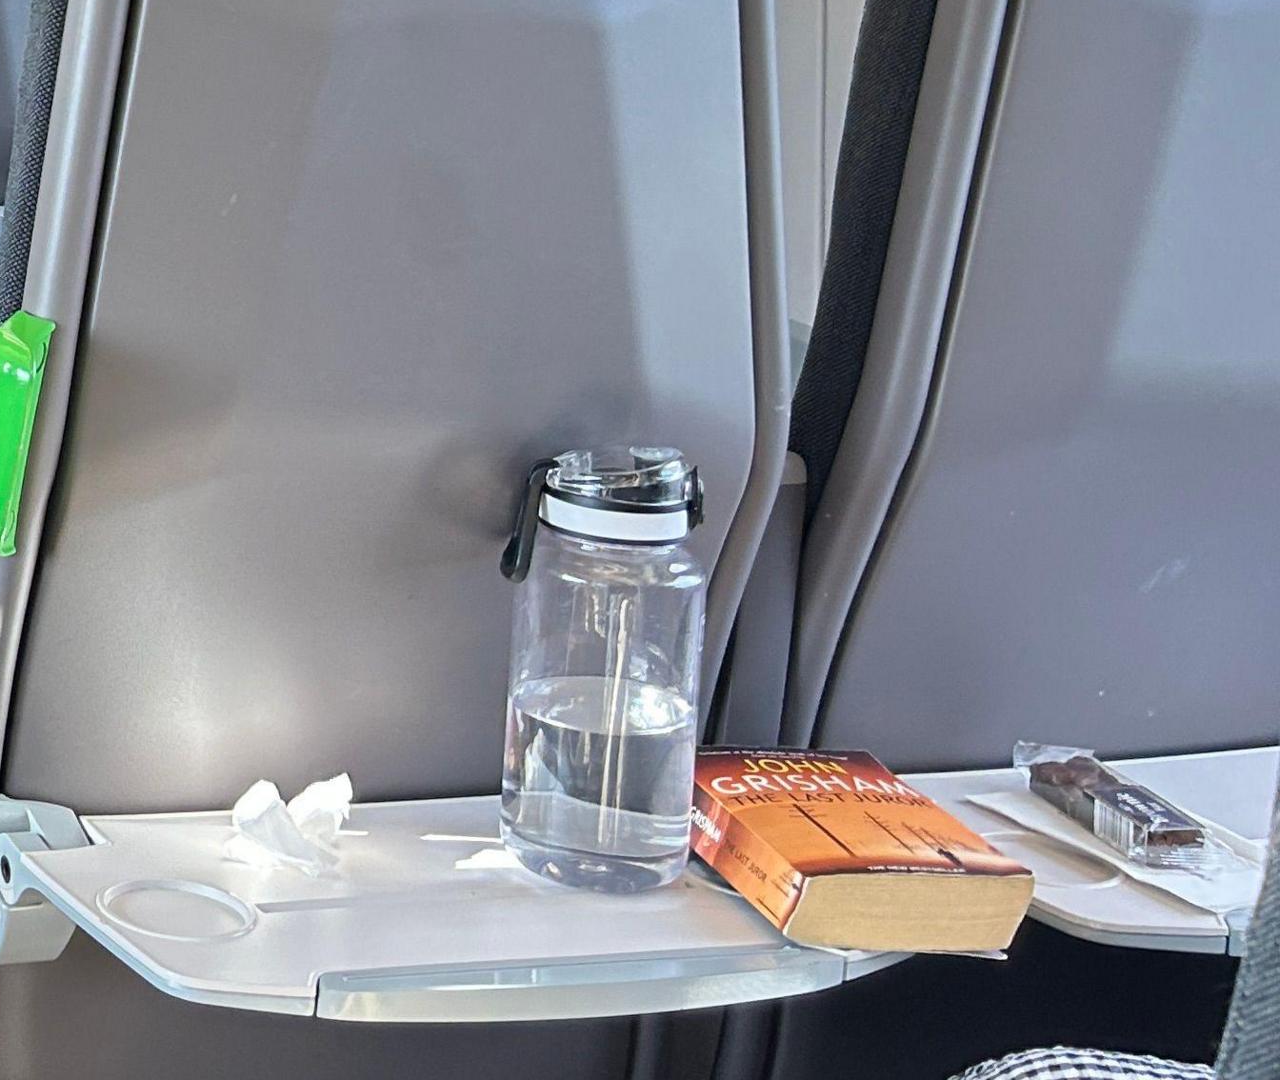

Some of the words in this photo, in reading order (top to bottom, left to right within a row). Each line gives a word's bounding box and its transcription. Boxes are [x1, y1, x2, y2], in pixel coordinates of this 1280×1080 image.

[744, 759, 849, 775] JOHN
[711, 773, 922, 799] GRISHAM
[728, 793, 778, 807] THE
[788, 792, 846, 804] LAST
[855, 793, 932, 808] JUROR
